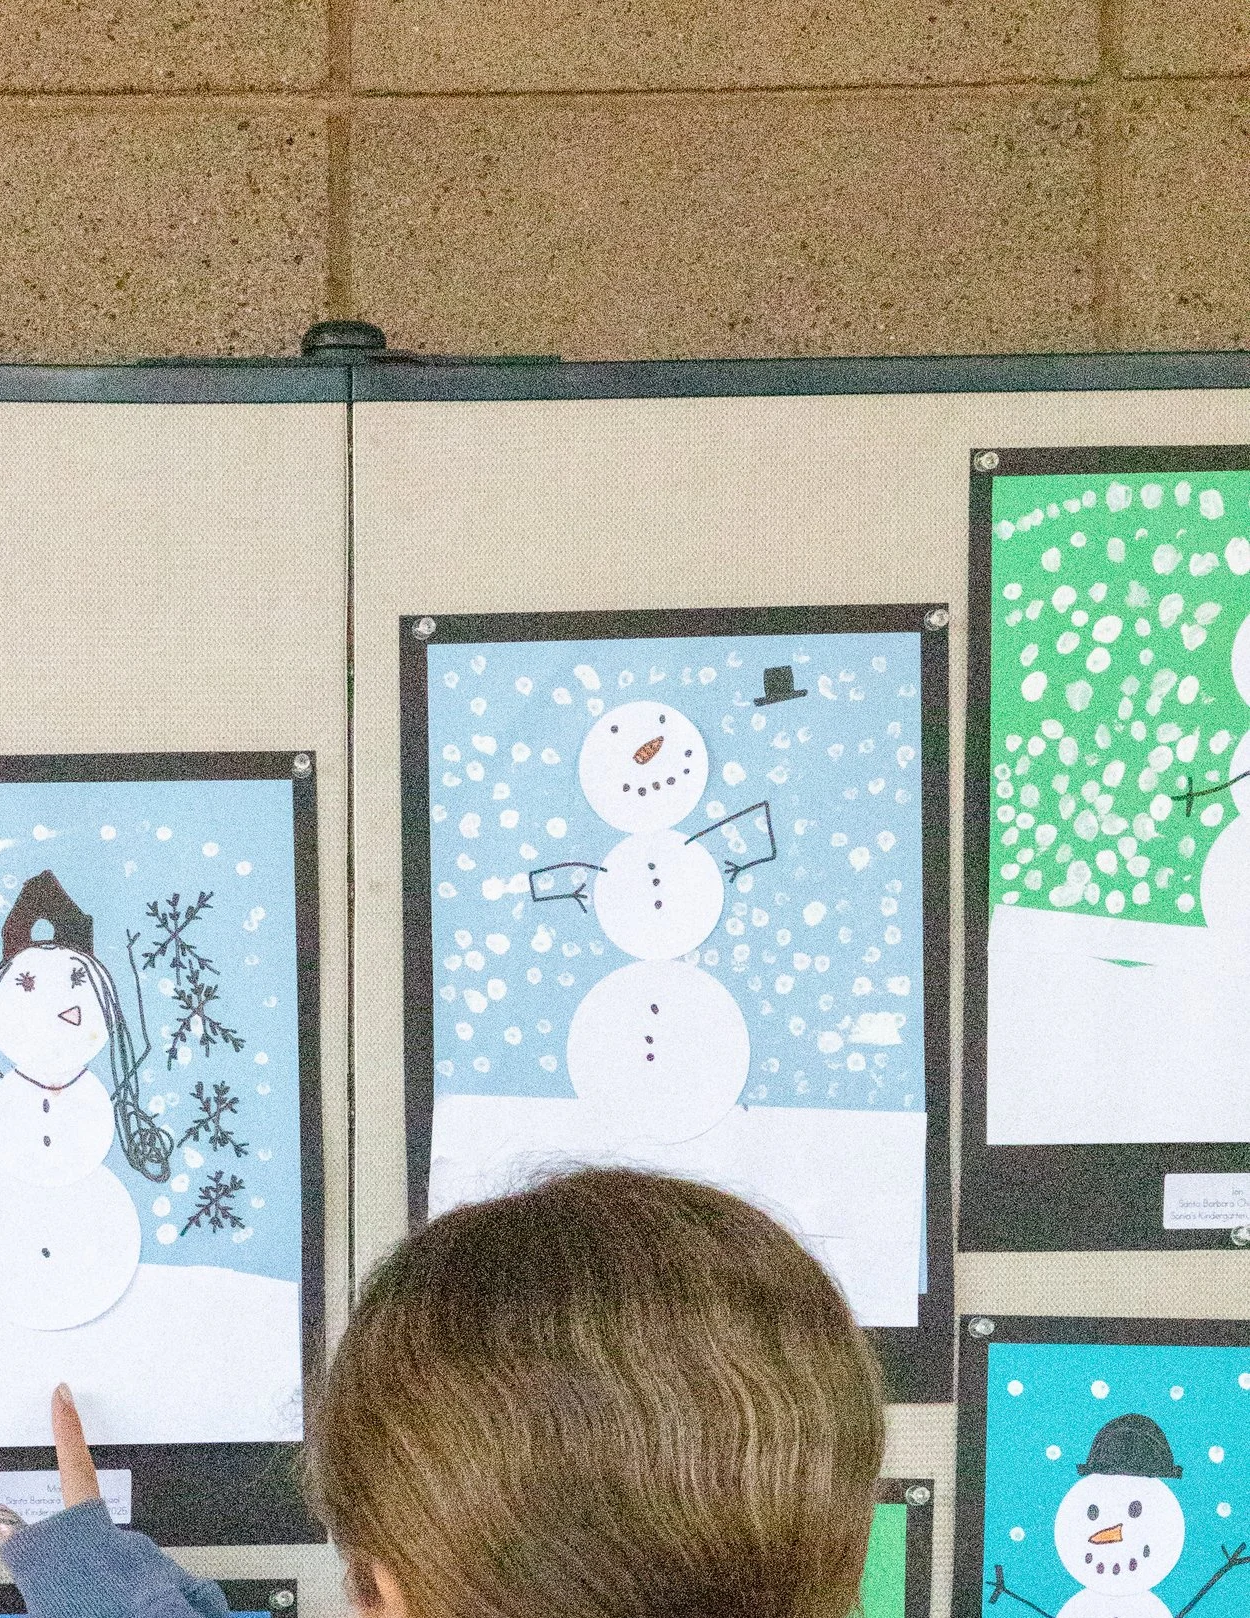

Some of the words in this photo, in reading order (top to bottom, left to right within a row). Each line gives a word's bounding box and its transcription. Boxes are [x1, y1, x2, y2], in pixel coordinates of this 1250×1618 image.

[1178, 1199, 1201, 1208] Santa
[1202, 1198, 1235, 1208] Barbara
[5, 1496, 28, 1505] Santa
[29, 1495, 62, 1505] Barbara
